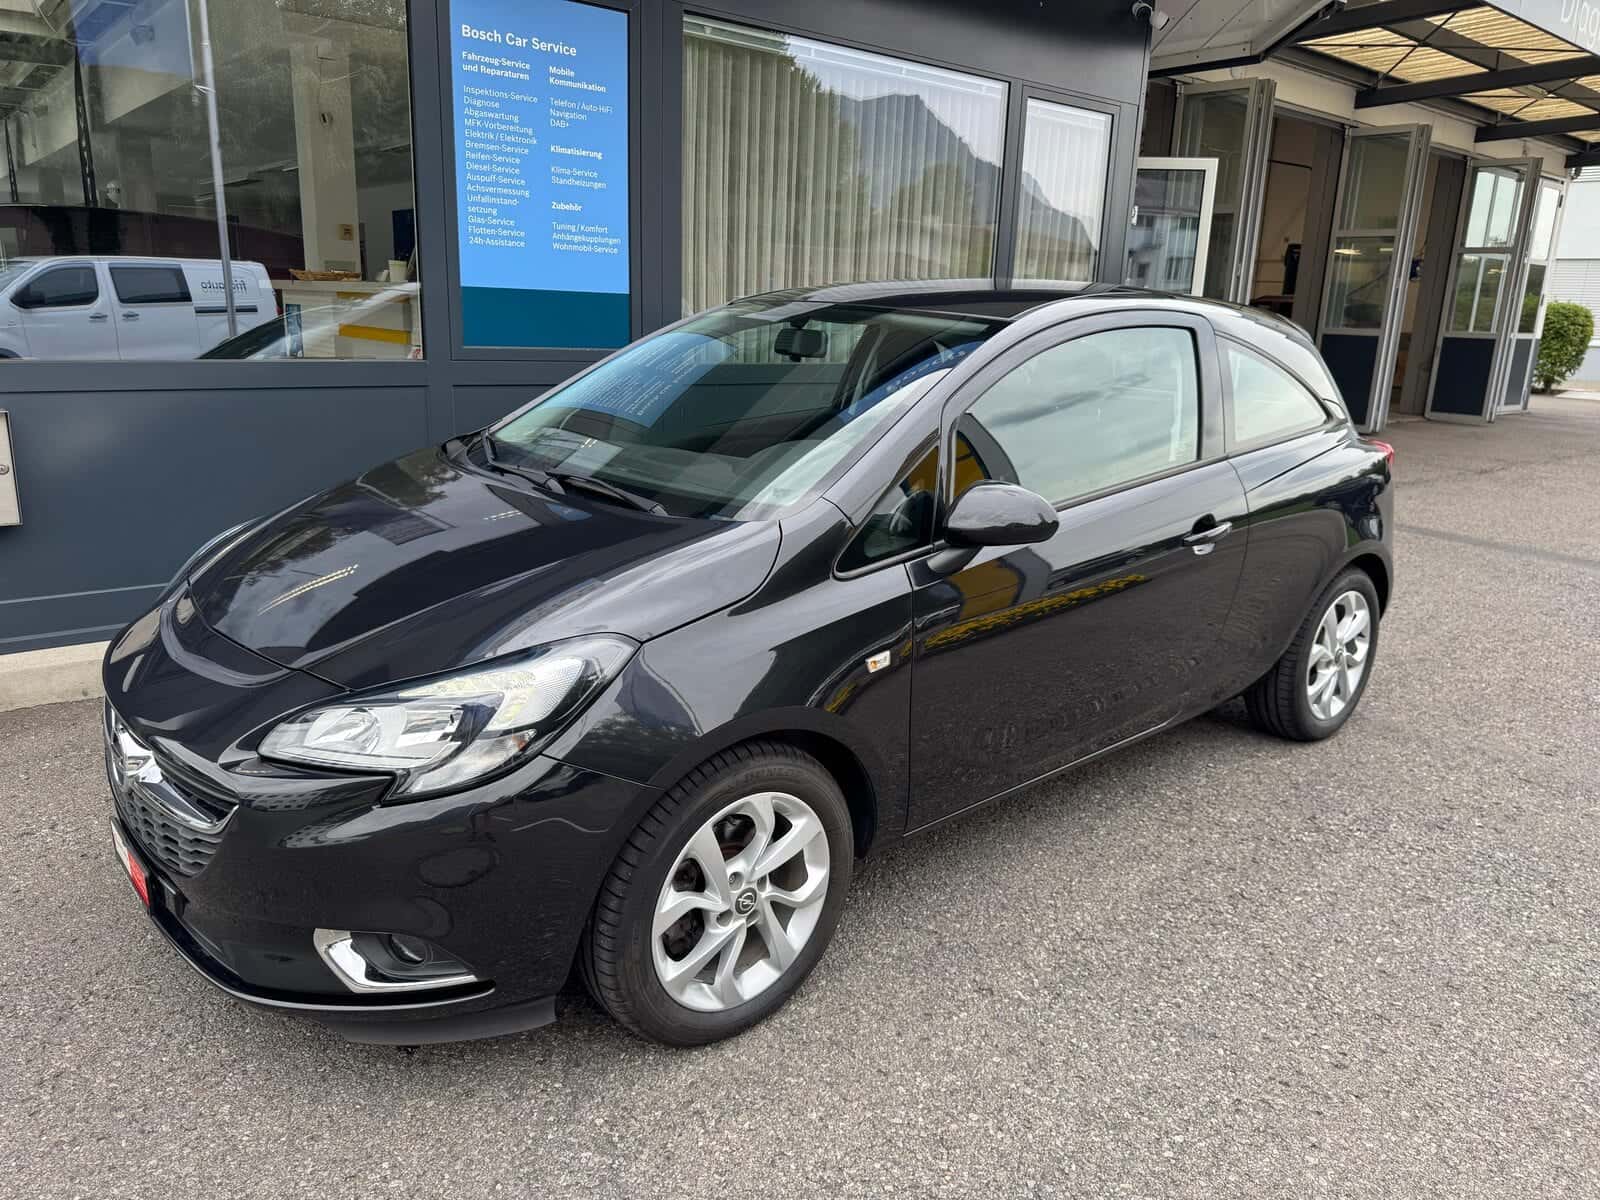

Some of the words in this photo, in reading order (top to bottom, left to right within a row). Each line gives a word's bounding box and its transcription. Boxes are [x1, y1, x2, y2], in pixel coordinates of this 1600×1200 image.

[461, 24, 502, 43] Bosch
[505, 32, 529, 48] Car
[531, 37, 577, 56] Service
[461, 51, 531, 70] Fahrzeug-Service
[462, 63, 478, 73] und
[480, 65, 530, 80] Reparaturen
[549, 66, 575, 77] Mobile
[549, 76, 607, 93] Kommunikation
[463, 85, 538, 103] Inspektions-Service
[463, 95, 500, 109] Diagnose
[549, 97, 576, 109] Telefon
[464, 106, 520, 123] Abgaswartung
[549, 108, 587, 121] Navigation
[464, 118, 534, 135] MFK-Vorbereitung
[464, 128, 495, 140] Elektrik
[500, 133, 537, 144] Elektronik
[465, 140, 529, 155] Bremsen-Service
[550, 144, 603, 160] Klimatisierung
[465, 150, 521, 164] Reifen-Service
[465, 161, 520, 175] Diesel-Service
[551, 166, 598, 178] Klima-Service
[466, 172, 526, 186] Auspuff-Service
[551, 176, 607, 189] Standheizungen
[466, 182, 530, 198] Achsvermessung
[467, 193, 520, 206] Unfallinstand-
[551, 201, 583, 212] Zubehör
[467, 206, 498, 216] setzung
[467, 215, 516, 226] Glas-Service
[552, 221, 576, 233] Tuning
[580, 224, 608, 233] Komfort
[468, 225, 526, 237] Flotten-Service
[552, 232, 621, 244] Anhängekupplungen
[468, 236, 526, 248] 24h-Assistance
[552, 242, 618, 254] Wohnmobil-Service
